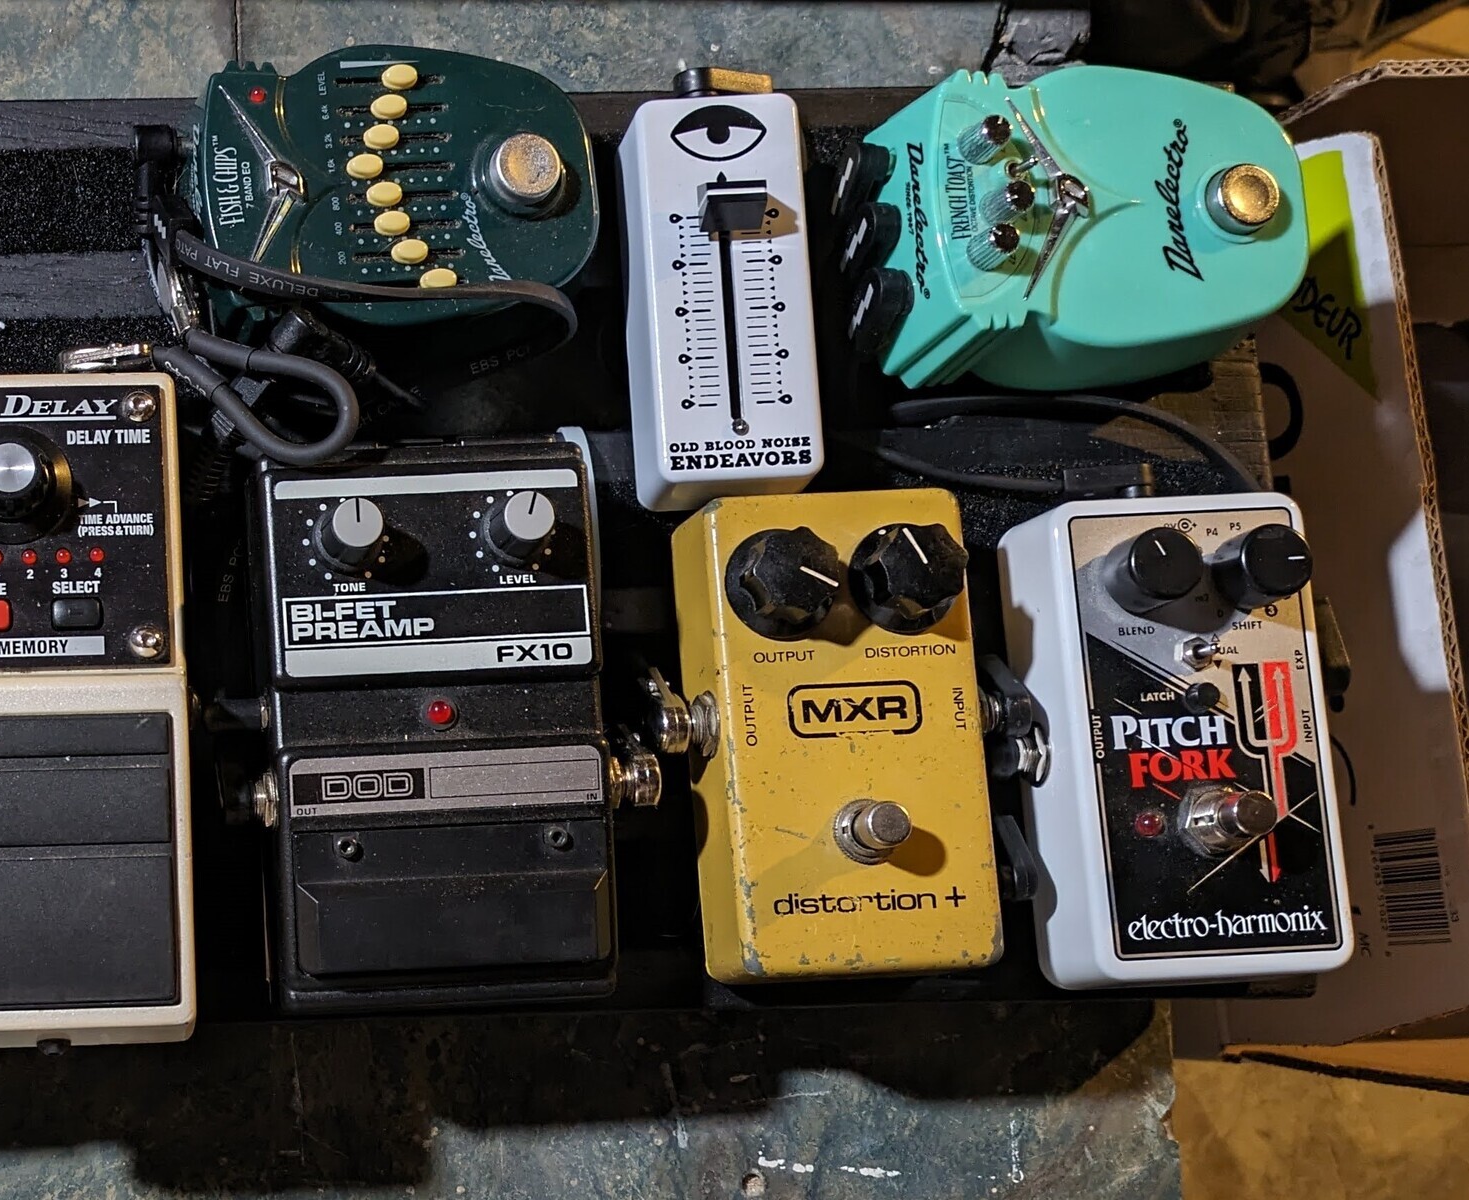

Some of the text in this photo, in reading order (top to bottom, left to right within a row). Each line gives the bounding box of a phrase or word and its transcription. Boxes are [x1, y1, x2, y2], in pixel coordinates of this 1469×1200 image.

[318, 71, 327, 96] LEVEL
[321, 104, 330, 120] 6.4k
[325, 133, 333, 149] 3.2k
[241, 161, 251, 174] EQ
[328, 158, 336, 173] 1.6k
[243, 176, 254, 201] BAND
[332, 196, 340, 211] 800
[966, 166, 978, 232] OCTAVE DISTORTION
[218, 195, 245, 226] FISH
[948, 193, 972, 240] FRENCH
[334, 222, 343, 236] 400
[338, 251, 347, 265] 200
[204, 255, 239, 278] FLAT
[249, 271, 319, 297] DELUXE
[0, 394, 118, 418] DELAY
[66, 429, 151, 445] DELAY TIME
[669, 436, 811, 453] OLD BLOOD NOISE
[670, 450, 812, 471] ENDEAVORS
[78, 513, 154, 525] TIME ADVANCE
[1229, 522, 1241, 531] P5
[1206, 528, 1218, 536] P4
[26, 569, 34, 580] 2
[60, 568, 68, 579] 3
[94, 567, 102, 578] 4
[499, 574, 536, 585] LEVEL
[52, 580, 101, 595] SELECT
[333, 582, 366, 593] TONE
[290, 601, 397, 622] BI-FET
[292, 617, 435, 641] PREAMP
[1118, 626, 1155, 637] BLEND
[1232, 620, 1262, 631] SHIFT
[496, 642, 573, 662] FX10
[753, 649, 815, 663] OUTPUT
[865, 644, 956, 659] DISTORTION
[1218, 645, 1239, 655] UAL
[1294, 650, 1304, 670] EXP
[1140, 691, 1175, 702] LATCH
[745, 684, 757, 747] OUTPUT
[802, 695, 908, 724] MXR
[954, 687, 966, 731] INPUT
[1111, 714, 1228, 750] PITCH
[1303, 708, 1313, 743] INPUT
[1094, 713, 1106, 759] OUTPUT
[1128, 748, 1237, 788] FORK
[320, 772, 414, 800] DOD
[586, 793, 598, 801] IN
[296, 807, 317, 816] OUT
[773, 888, 937, 915] distortion
[1127, 904, 1329, 940] electro-harmonix
